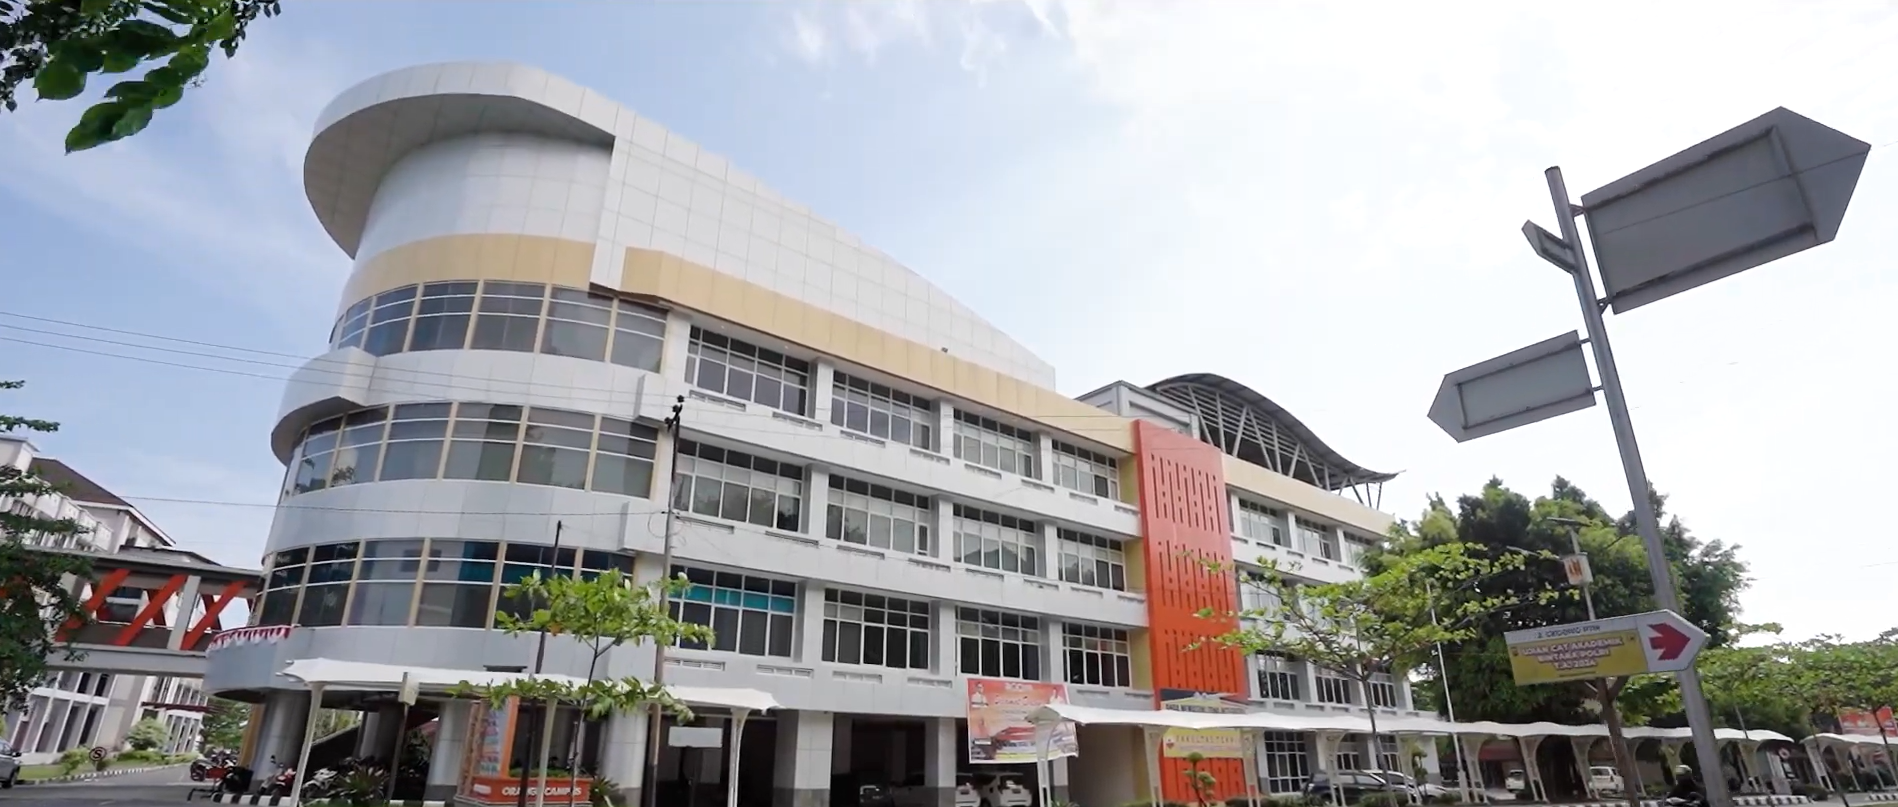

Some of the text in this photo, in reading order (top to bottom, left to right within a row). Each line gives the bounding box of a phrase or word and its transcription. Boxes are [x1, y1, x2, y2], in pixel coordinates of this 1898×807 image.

[1522, 638, 1623, 656] UJIAN CAT AKADEMIK
[1537, 647, 1610, 663] BINTARA POLRI
[93, 749, 102, 759] S
[501, 786, 540, 796] ORAG
